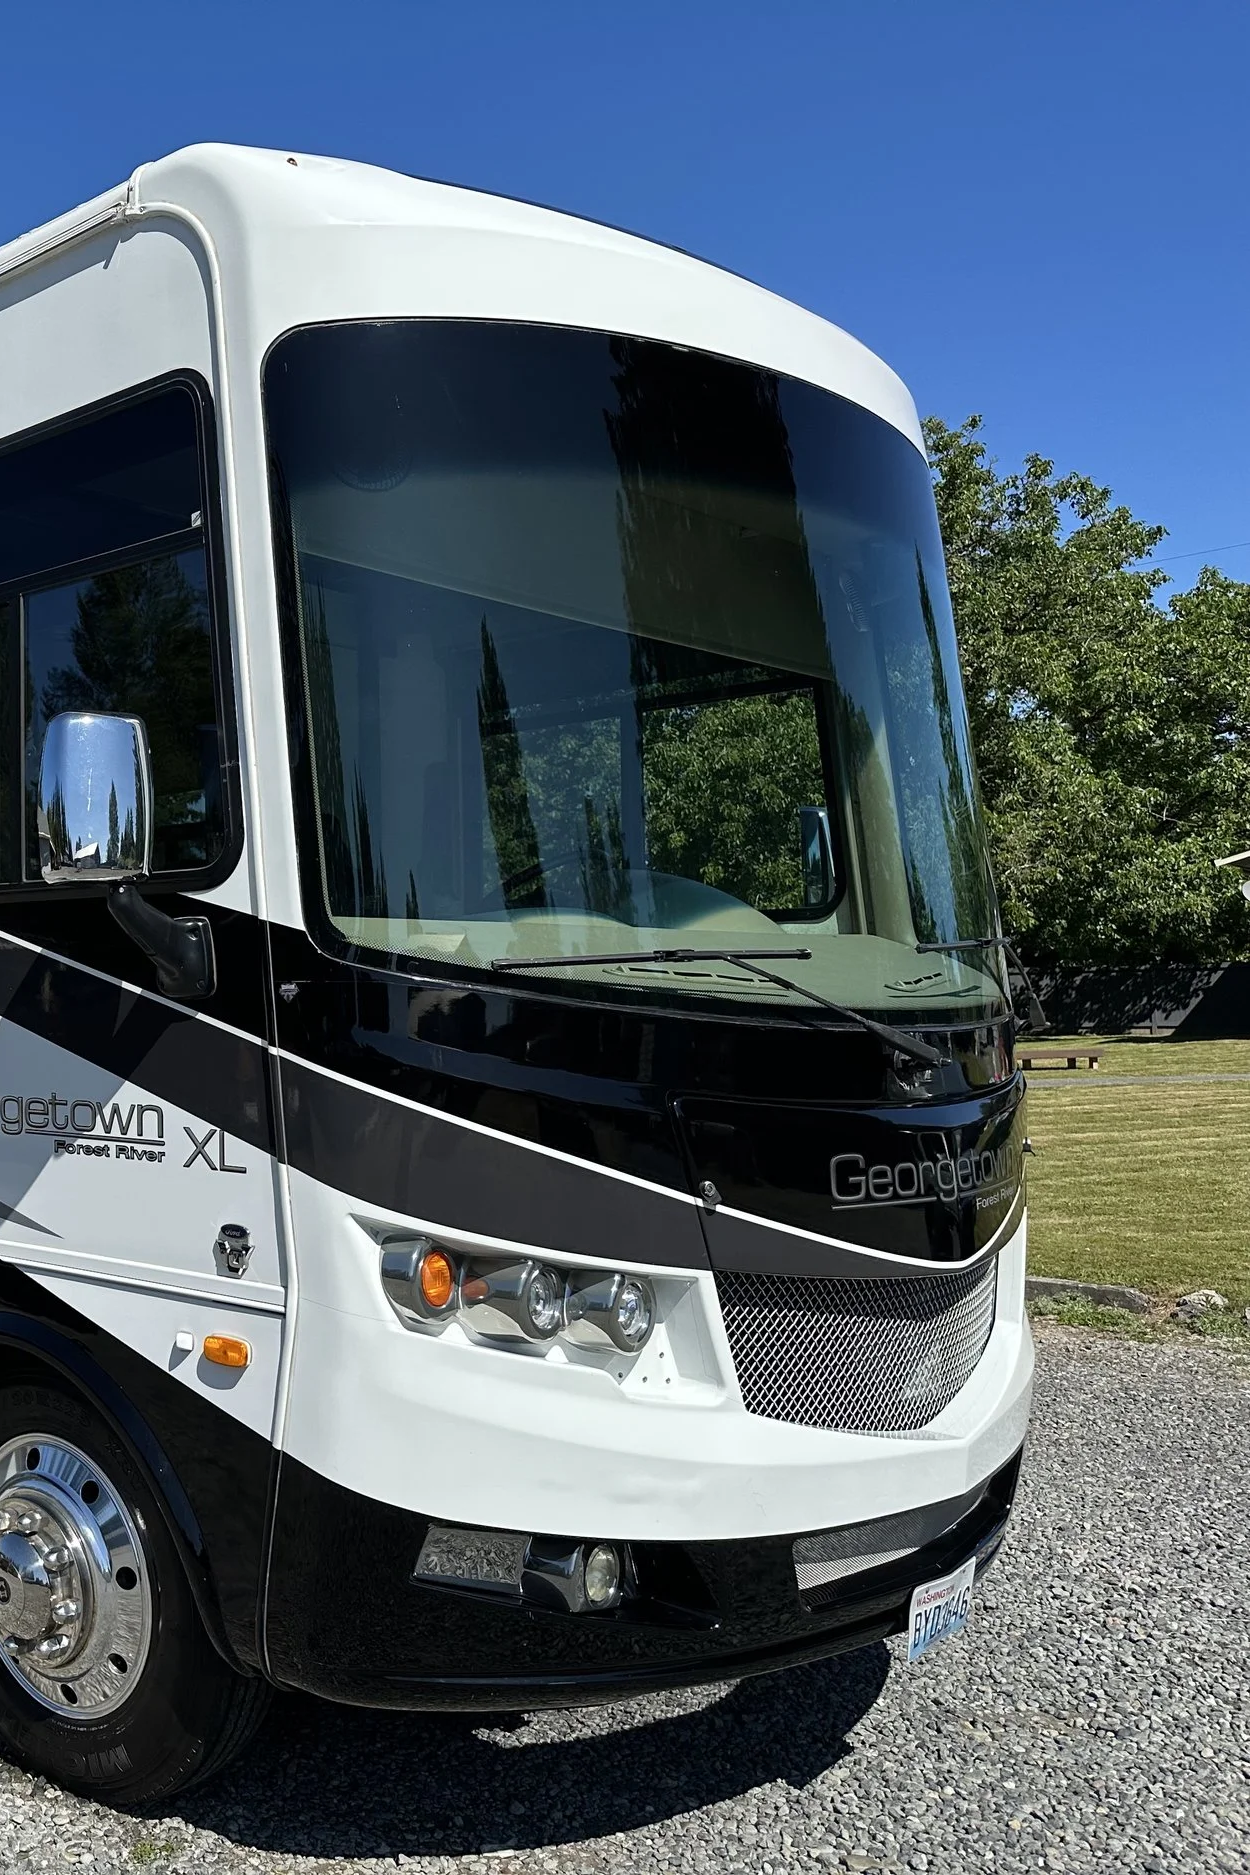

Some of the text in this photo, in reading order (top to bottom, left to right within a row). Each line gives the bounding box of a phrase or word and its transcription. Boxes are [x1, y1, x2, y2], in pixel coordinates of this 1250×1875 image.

[54, 1140, 166, 1163] Forest River
[183, 1126, 247, 1174] XL
[830, 1144, 1014, 1201] Georgetown
[976, 1186, 1015, 1211] Forest River
[916, 1585, 955, 1607] WASHINGTON
